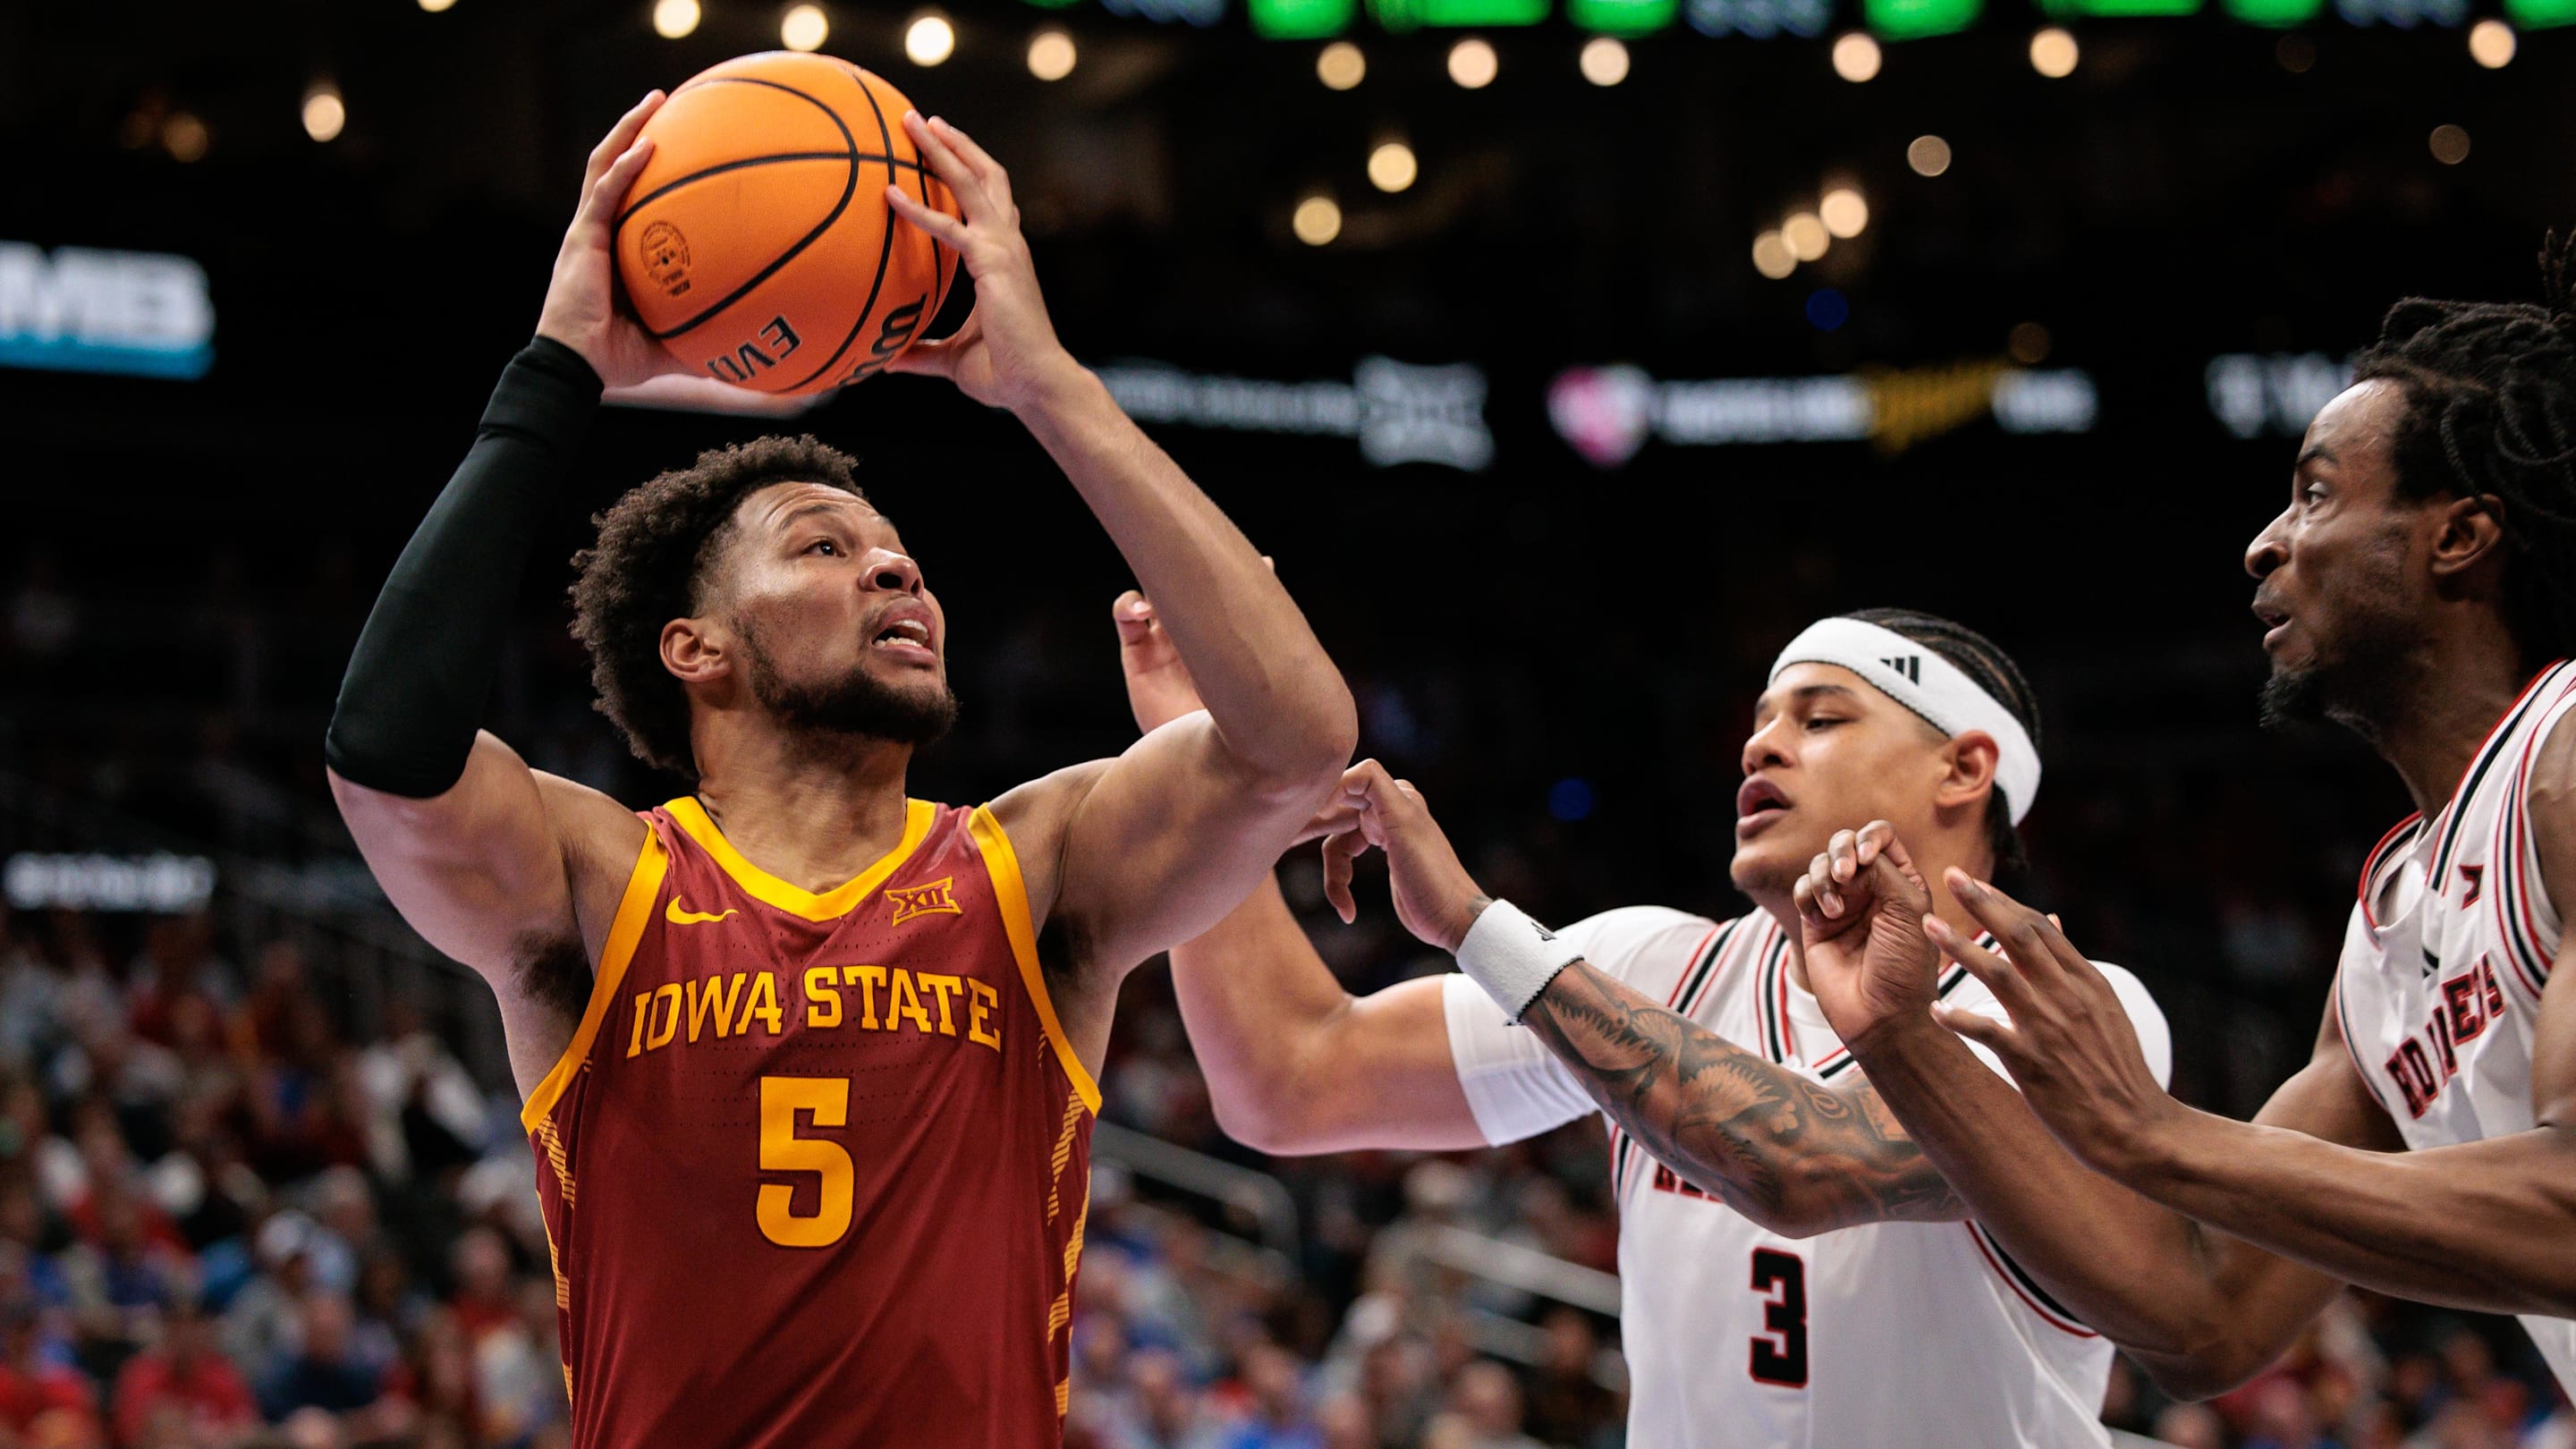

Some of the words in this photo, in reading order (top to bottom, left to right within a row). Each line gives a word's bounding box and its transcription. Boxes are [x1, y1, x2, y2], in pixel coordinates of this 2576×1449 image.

[626, 970, 784, 1059] IOWA
[803, 964, 1002, 1055] STATE
[755, 1075, 855, 1250] 5
[1749, 1246, 1809, 1389] 3
